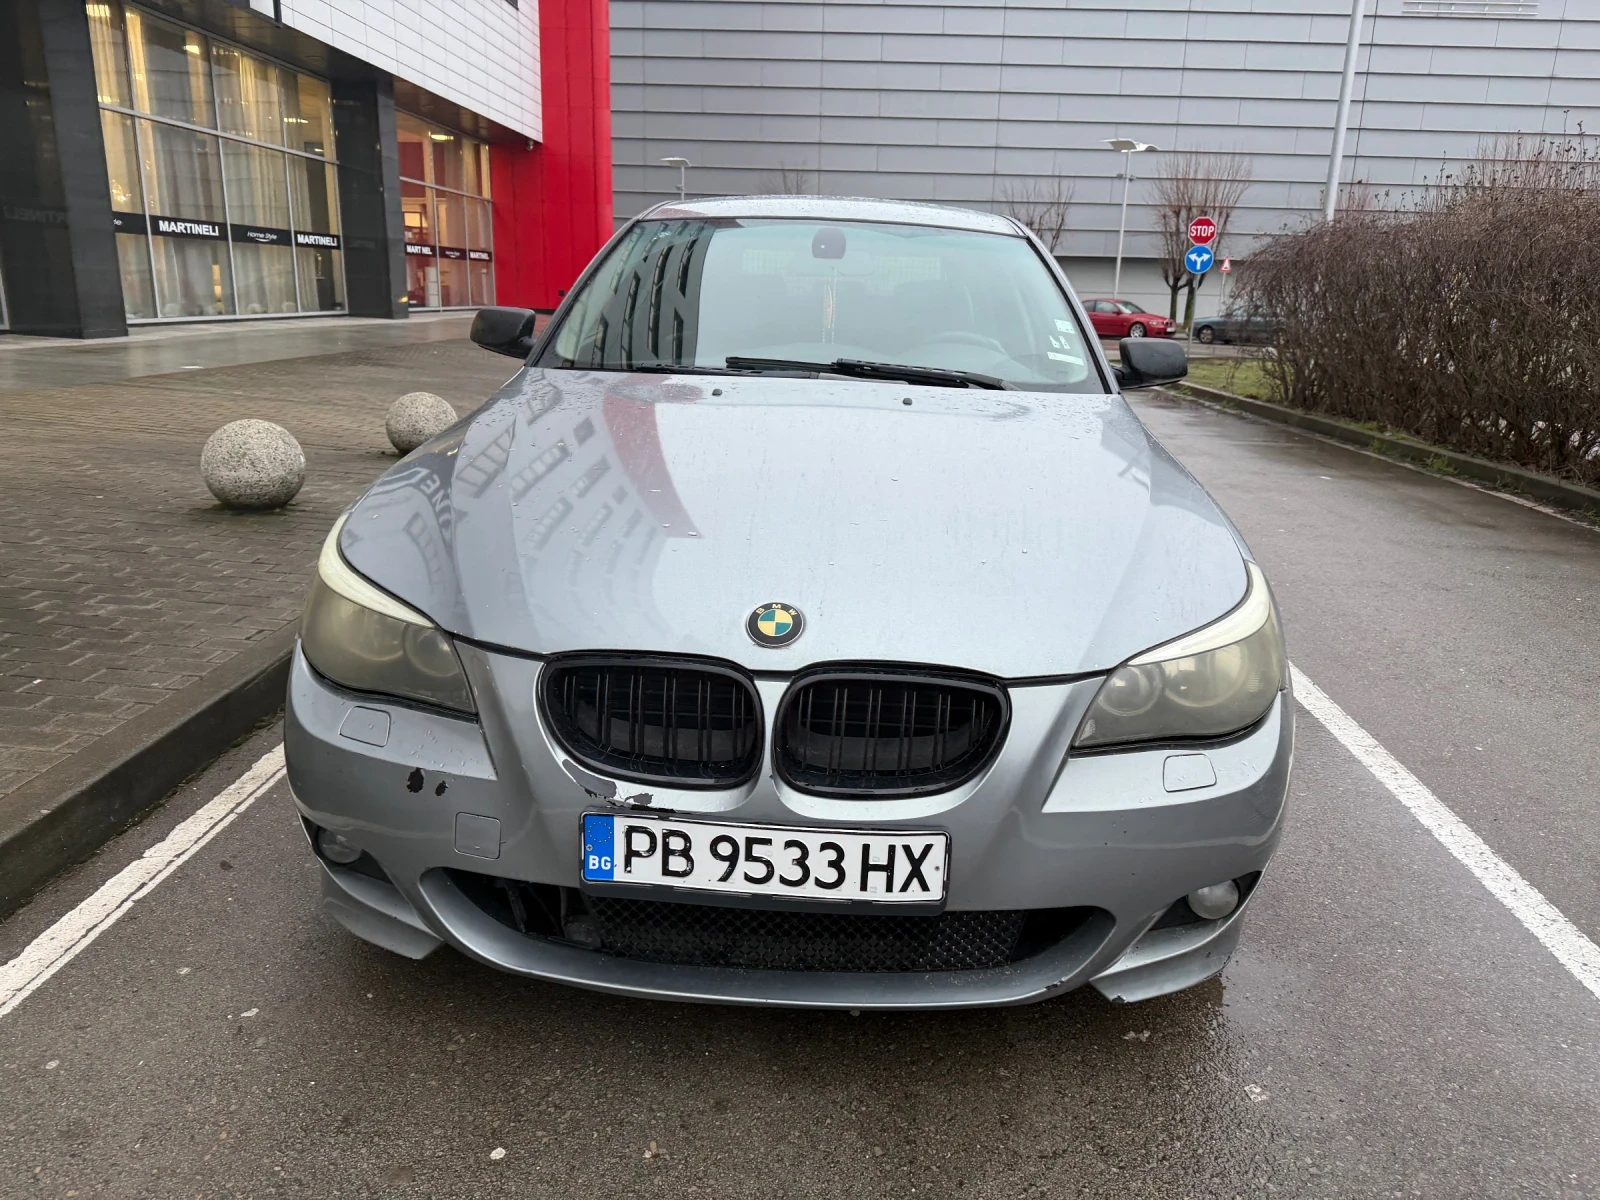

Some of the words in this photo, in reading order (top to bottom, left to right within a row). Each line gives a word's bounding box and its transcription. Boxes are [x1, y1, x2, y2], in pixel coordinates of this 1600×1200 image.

[158, 220, 219, 236] MARTINELI
[1190, 225, 1215, 237] STOP
[247, 231, 265, 239] Home
[265, 232, 278, 240] Style
[297, 233, 337, 246] MARTINELI
[755, 603, 798, 616] BMW
[588, 855, 611, 870] BG
[624, 825, 695, 878] PB
[709, 834, 846, 890] 9533
[859, 843, 935, 893] HX
